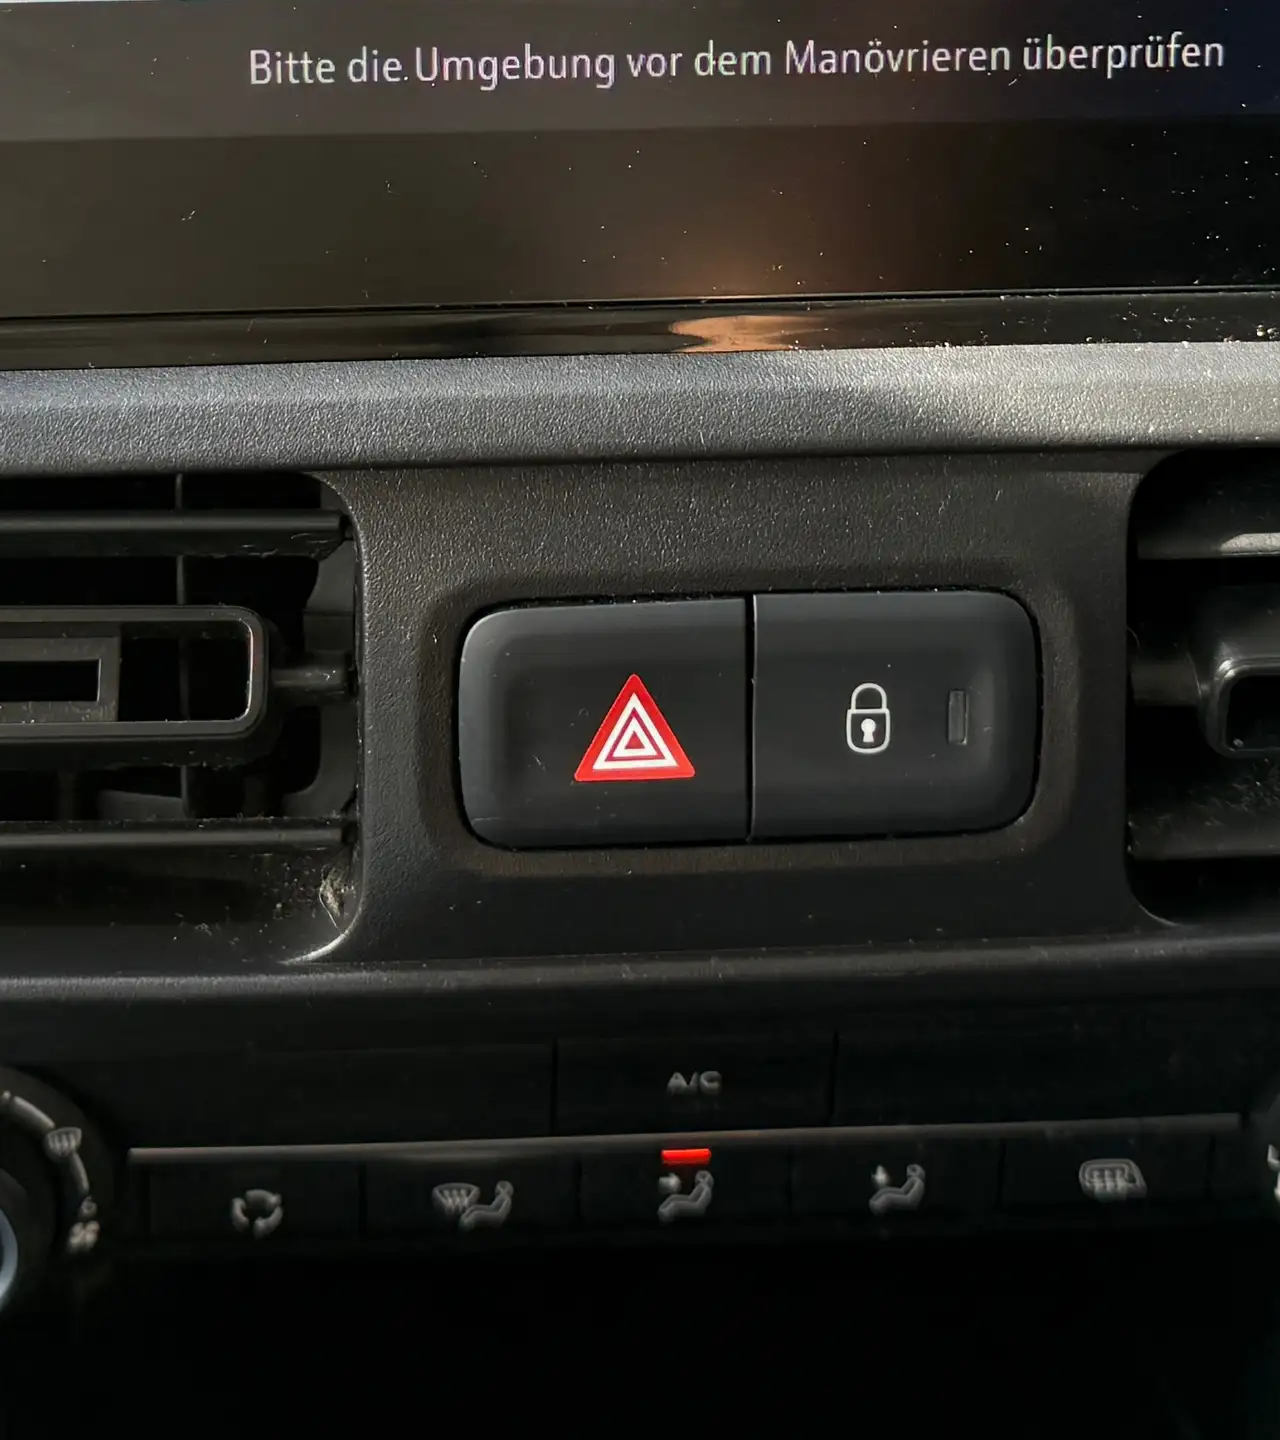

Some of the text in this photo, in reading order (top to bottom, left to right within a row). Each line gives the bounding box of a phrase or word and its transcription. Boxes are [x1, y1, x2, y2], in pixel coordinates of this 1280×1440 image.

[249, 31, 1224, 91] Bitte die Umgebung vor dem Manövrieren überprüfen
[666, 1070, 722, 1096] A/C
